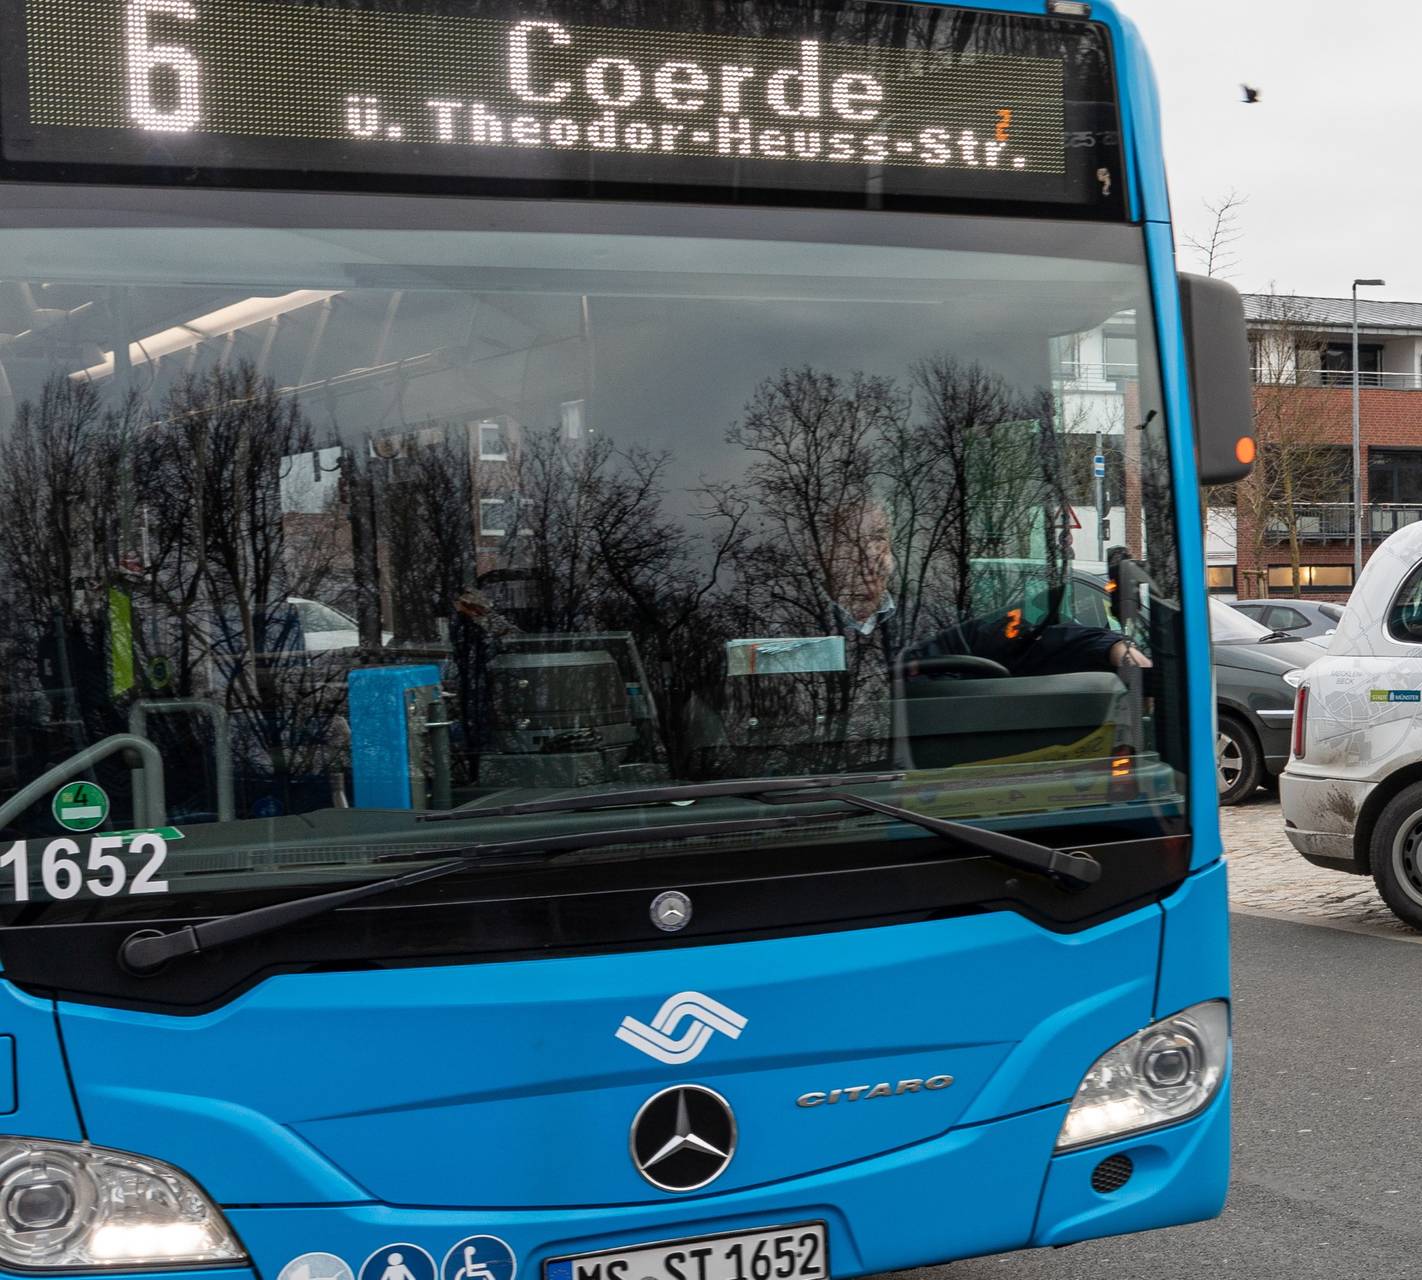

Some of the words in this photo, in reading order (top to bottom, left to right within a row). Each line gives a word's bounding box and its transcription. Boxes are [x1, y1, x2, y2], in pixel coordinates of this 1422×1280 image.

[127, 0, 200, 132] 6
[509, 20, 884, 120] Coerde
[427, 100, 1027, 169] Theodor-Heuss-Str.
[1395, 693, 1419, 701] MÜNSTER
[73, 785, 88, 805] 4
[0, 834, 169, 901] 1652
[796, 1074, 954, 1107] CITARO
[664, 1247, 712, 1280] ST
[724, 1233, 821, 1280] 1652
